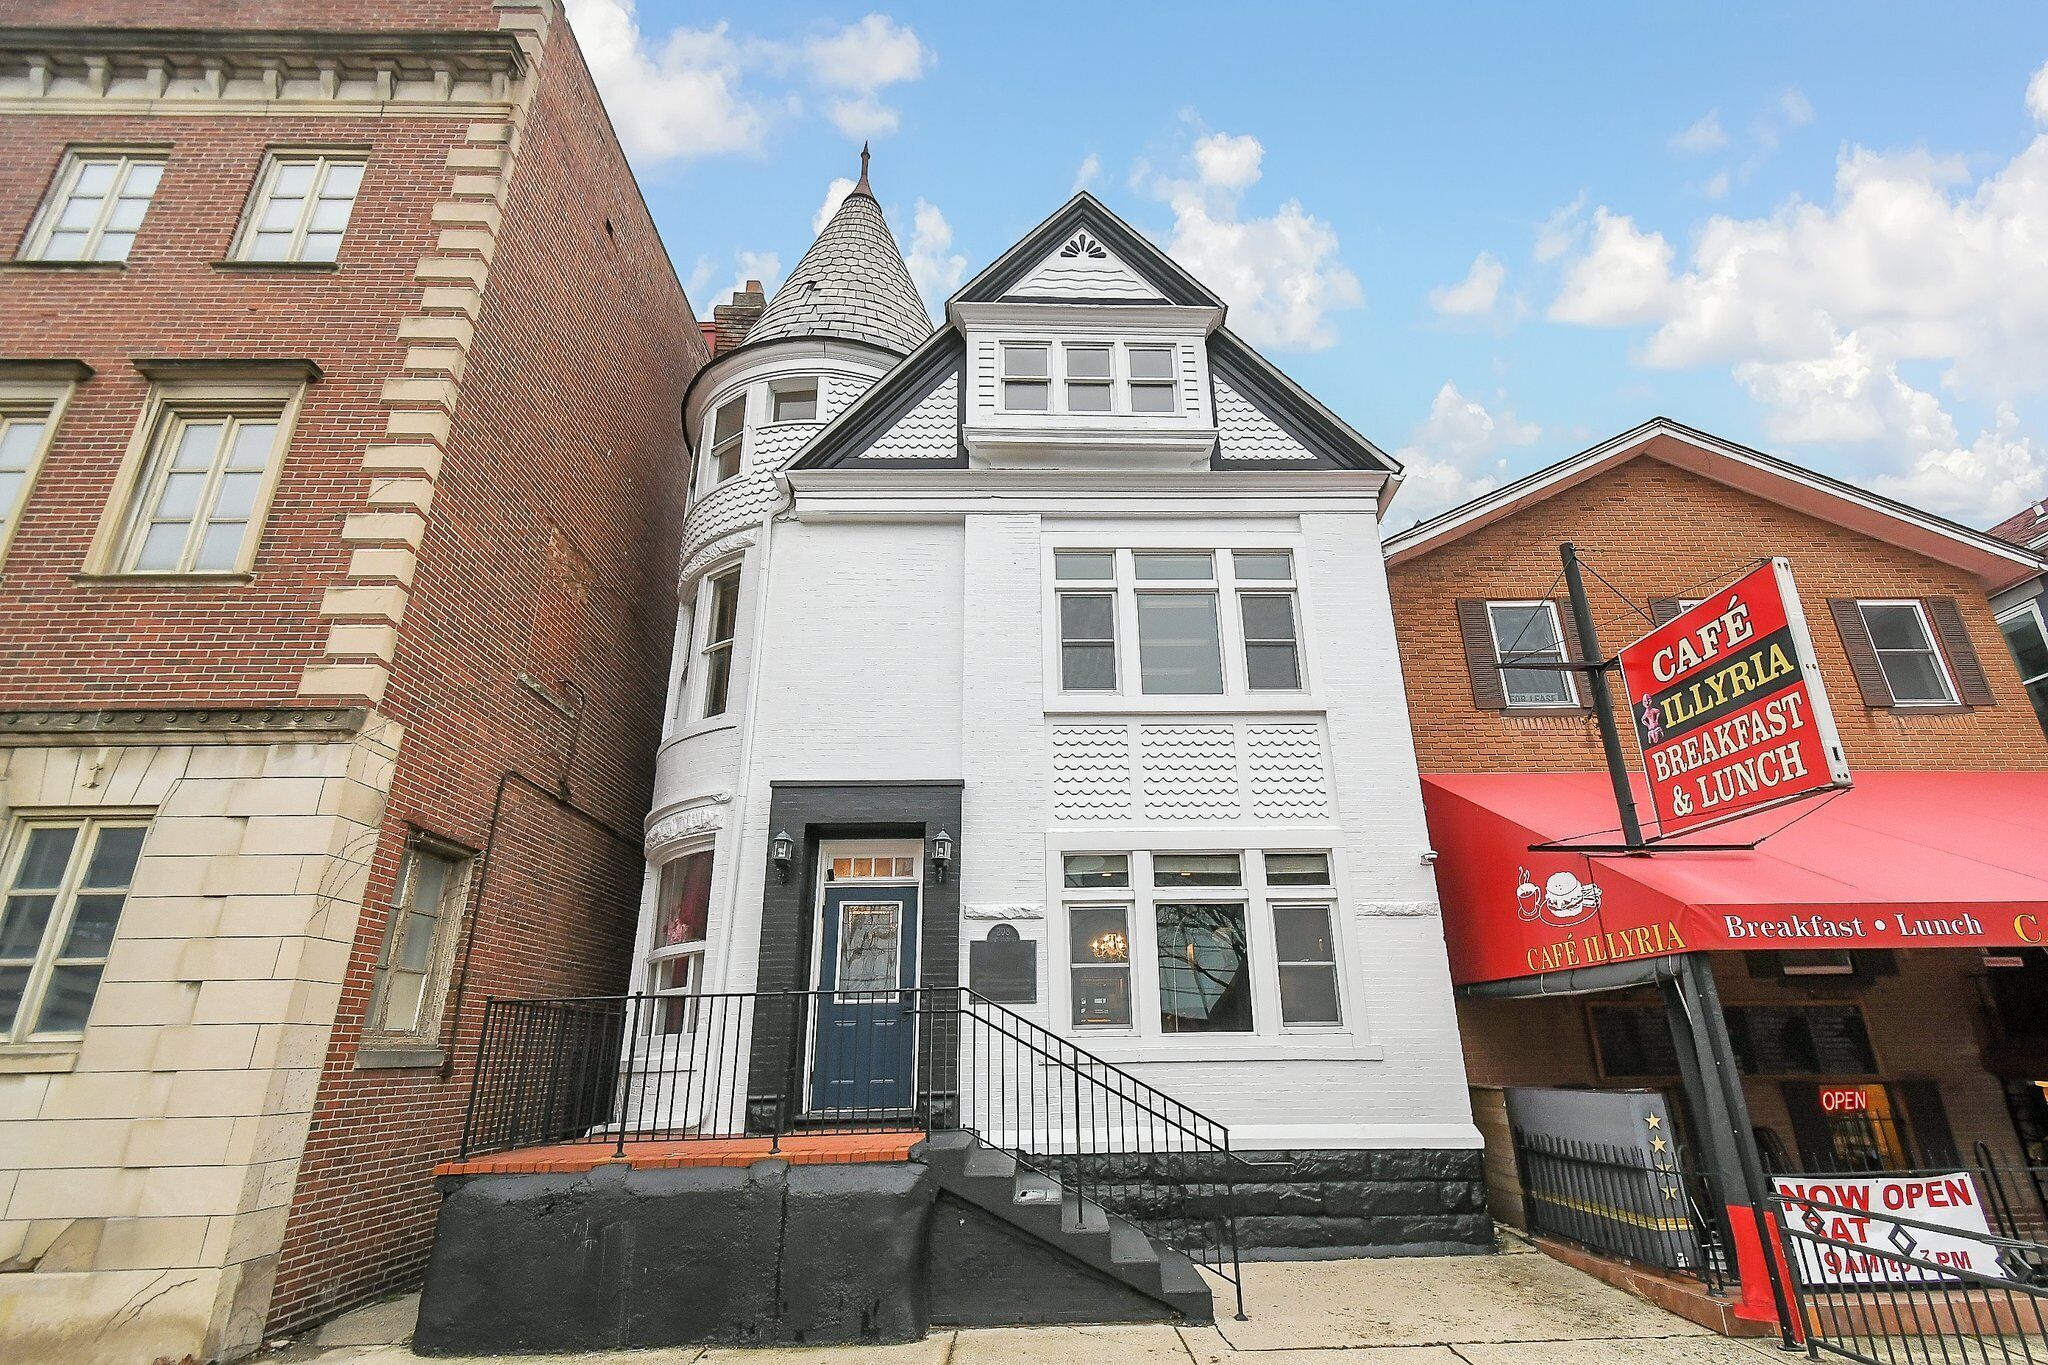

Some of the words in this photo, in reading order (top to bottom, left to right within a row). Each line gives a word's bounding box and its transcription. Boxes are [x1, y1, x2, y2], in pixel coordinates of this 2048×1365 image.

[1652, 594, 1754, 682] CAFÉ
[1510, 694, 1526, 702] FOR
[1660, 642, 1795, 729] ILLYRIA
[1652, 691, 1803, 782] BREAKFAST
[1672, 785, 1694, 817] &
[1696, 740, 1808, 808] LUNCH
[1527, 933, 1580, 971] CAFÉ
[1582, 920, 1687, 963] ILLYRIA
[1722, 914, 1867, 939] Breakfast
[1894, 912, 1984, 936] Lunch
[2013, 913, 2048, 943] C
[1822, 1091, 1866, 1111] OPEN
[1779, 1184, 1870, 1212] NOW
[1882, 1178, 1973, 1211] OPEN
